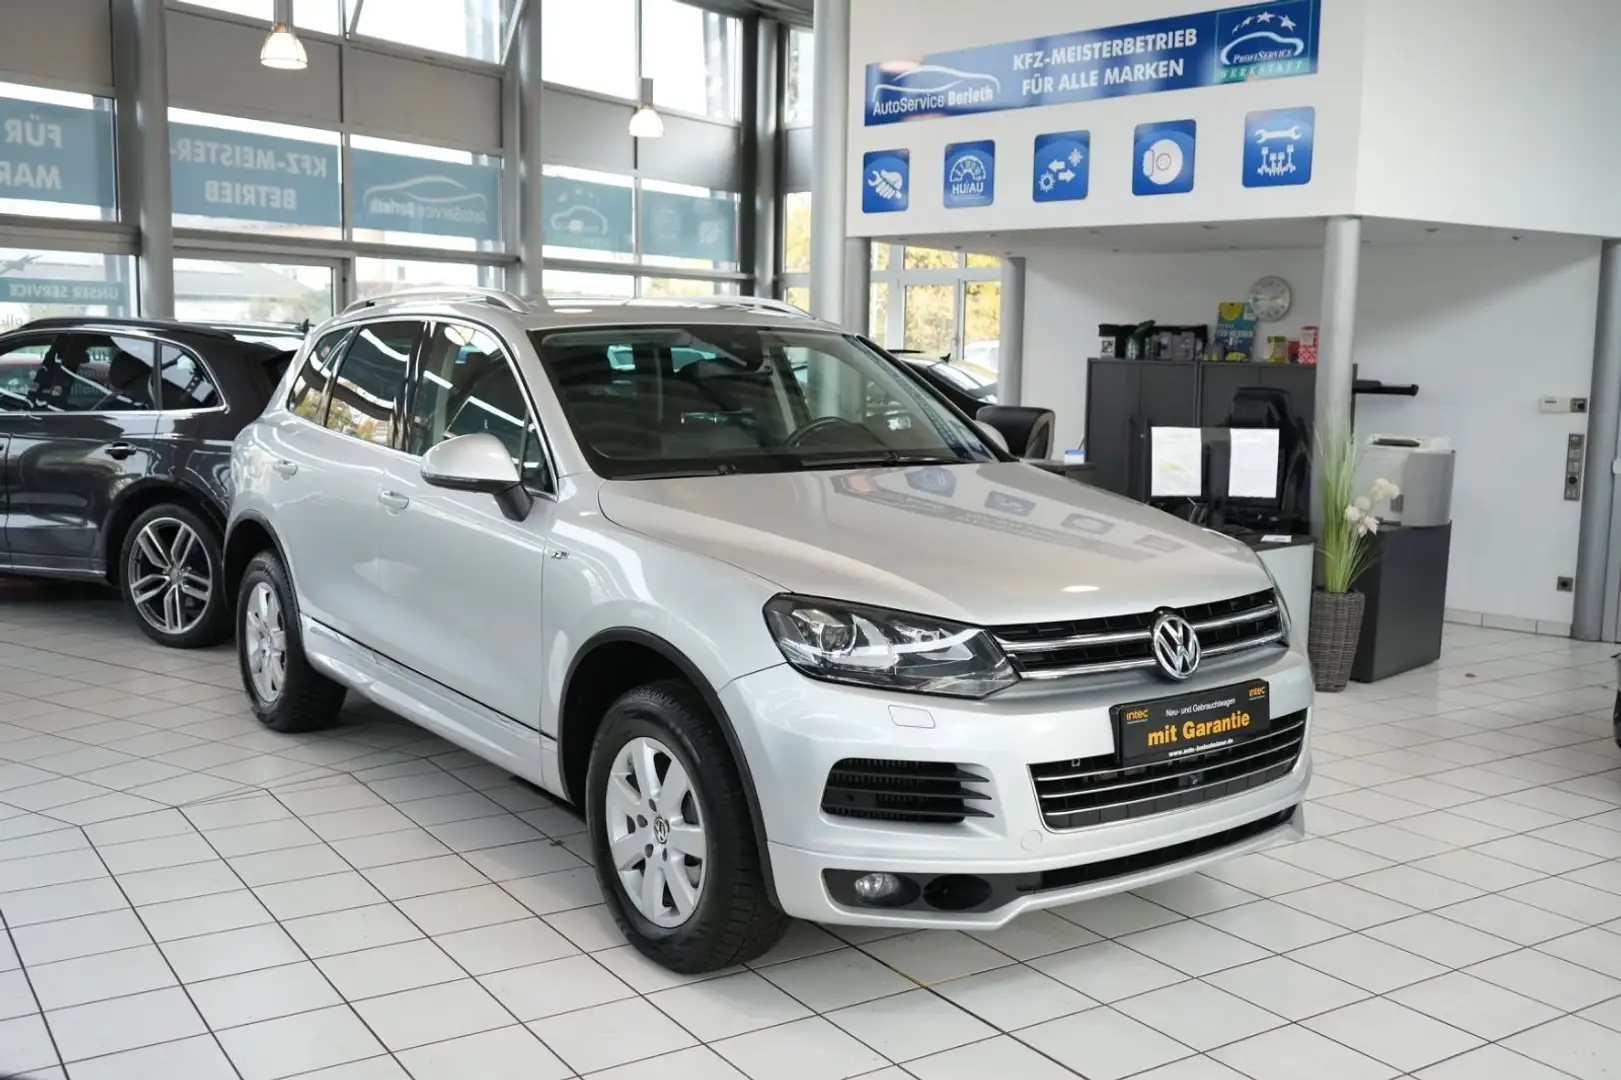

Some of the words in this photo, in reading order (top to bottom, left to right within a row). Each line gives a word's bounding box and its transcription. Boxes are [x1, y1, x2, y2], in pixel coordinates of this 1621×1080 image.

[1013, 28, 1197, 71] KFZ-MEISTERBETRIEB
[1022, 73, 1053, 96] FÜR
[1058, 70, 1098, 91] ALLE
[1104, 59, 1184, 86] MARKEN
[873, 93, 945, 116] AutoService
[948, 85, 993, 106] Berleth
[1181, 705, 1192, 714] und
[1193, 698, 1236, 712] Gebrauchtwagen
[1249, 686, 1266, 697] intec
[1126, 709, 1148, 721] intec
[1148, 725, 1177, 746] mit
[1183, 711, 1250, 740] Garantie
